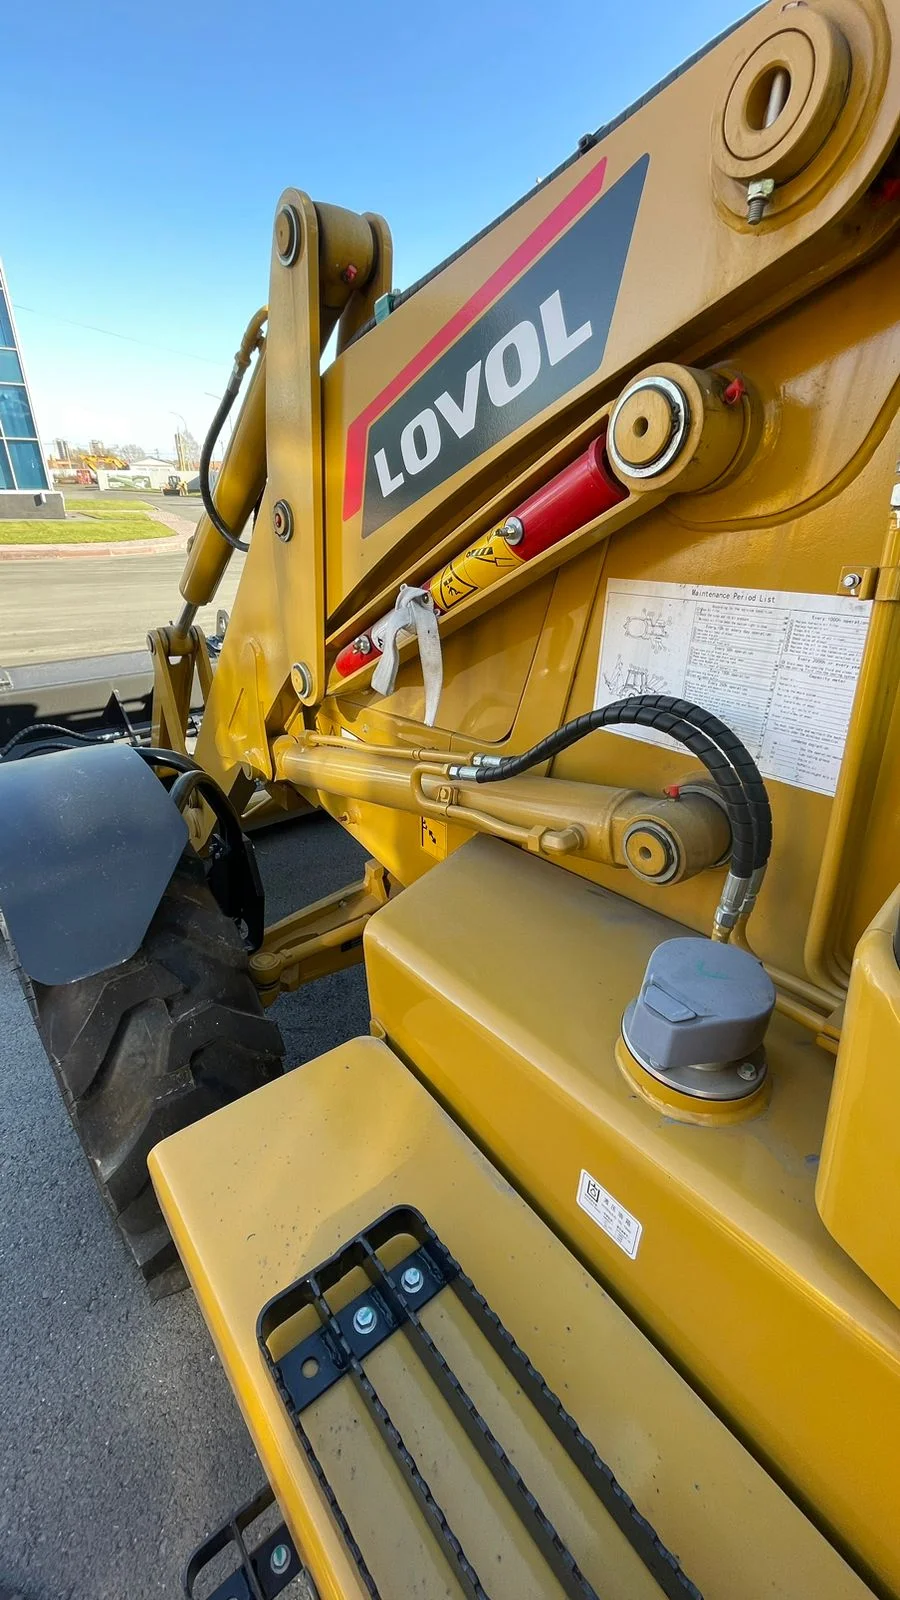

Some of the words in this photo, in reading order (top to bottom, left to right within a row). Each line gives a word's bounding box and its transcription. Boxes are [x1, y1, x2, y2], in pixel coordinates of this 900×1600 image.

[374, 289, 592, 497] LOVOL
[691, 588, 731, 600] Maintenance
[733, 592, 757, 602] Period
[759, 595, 776, 603] List
